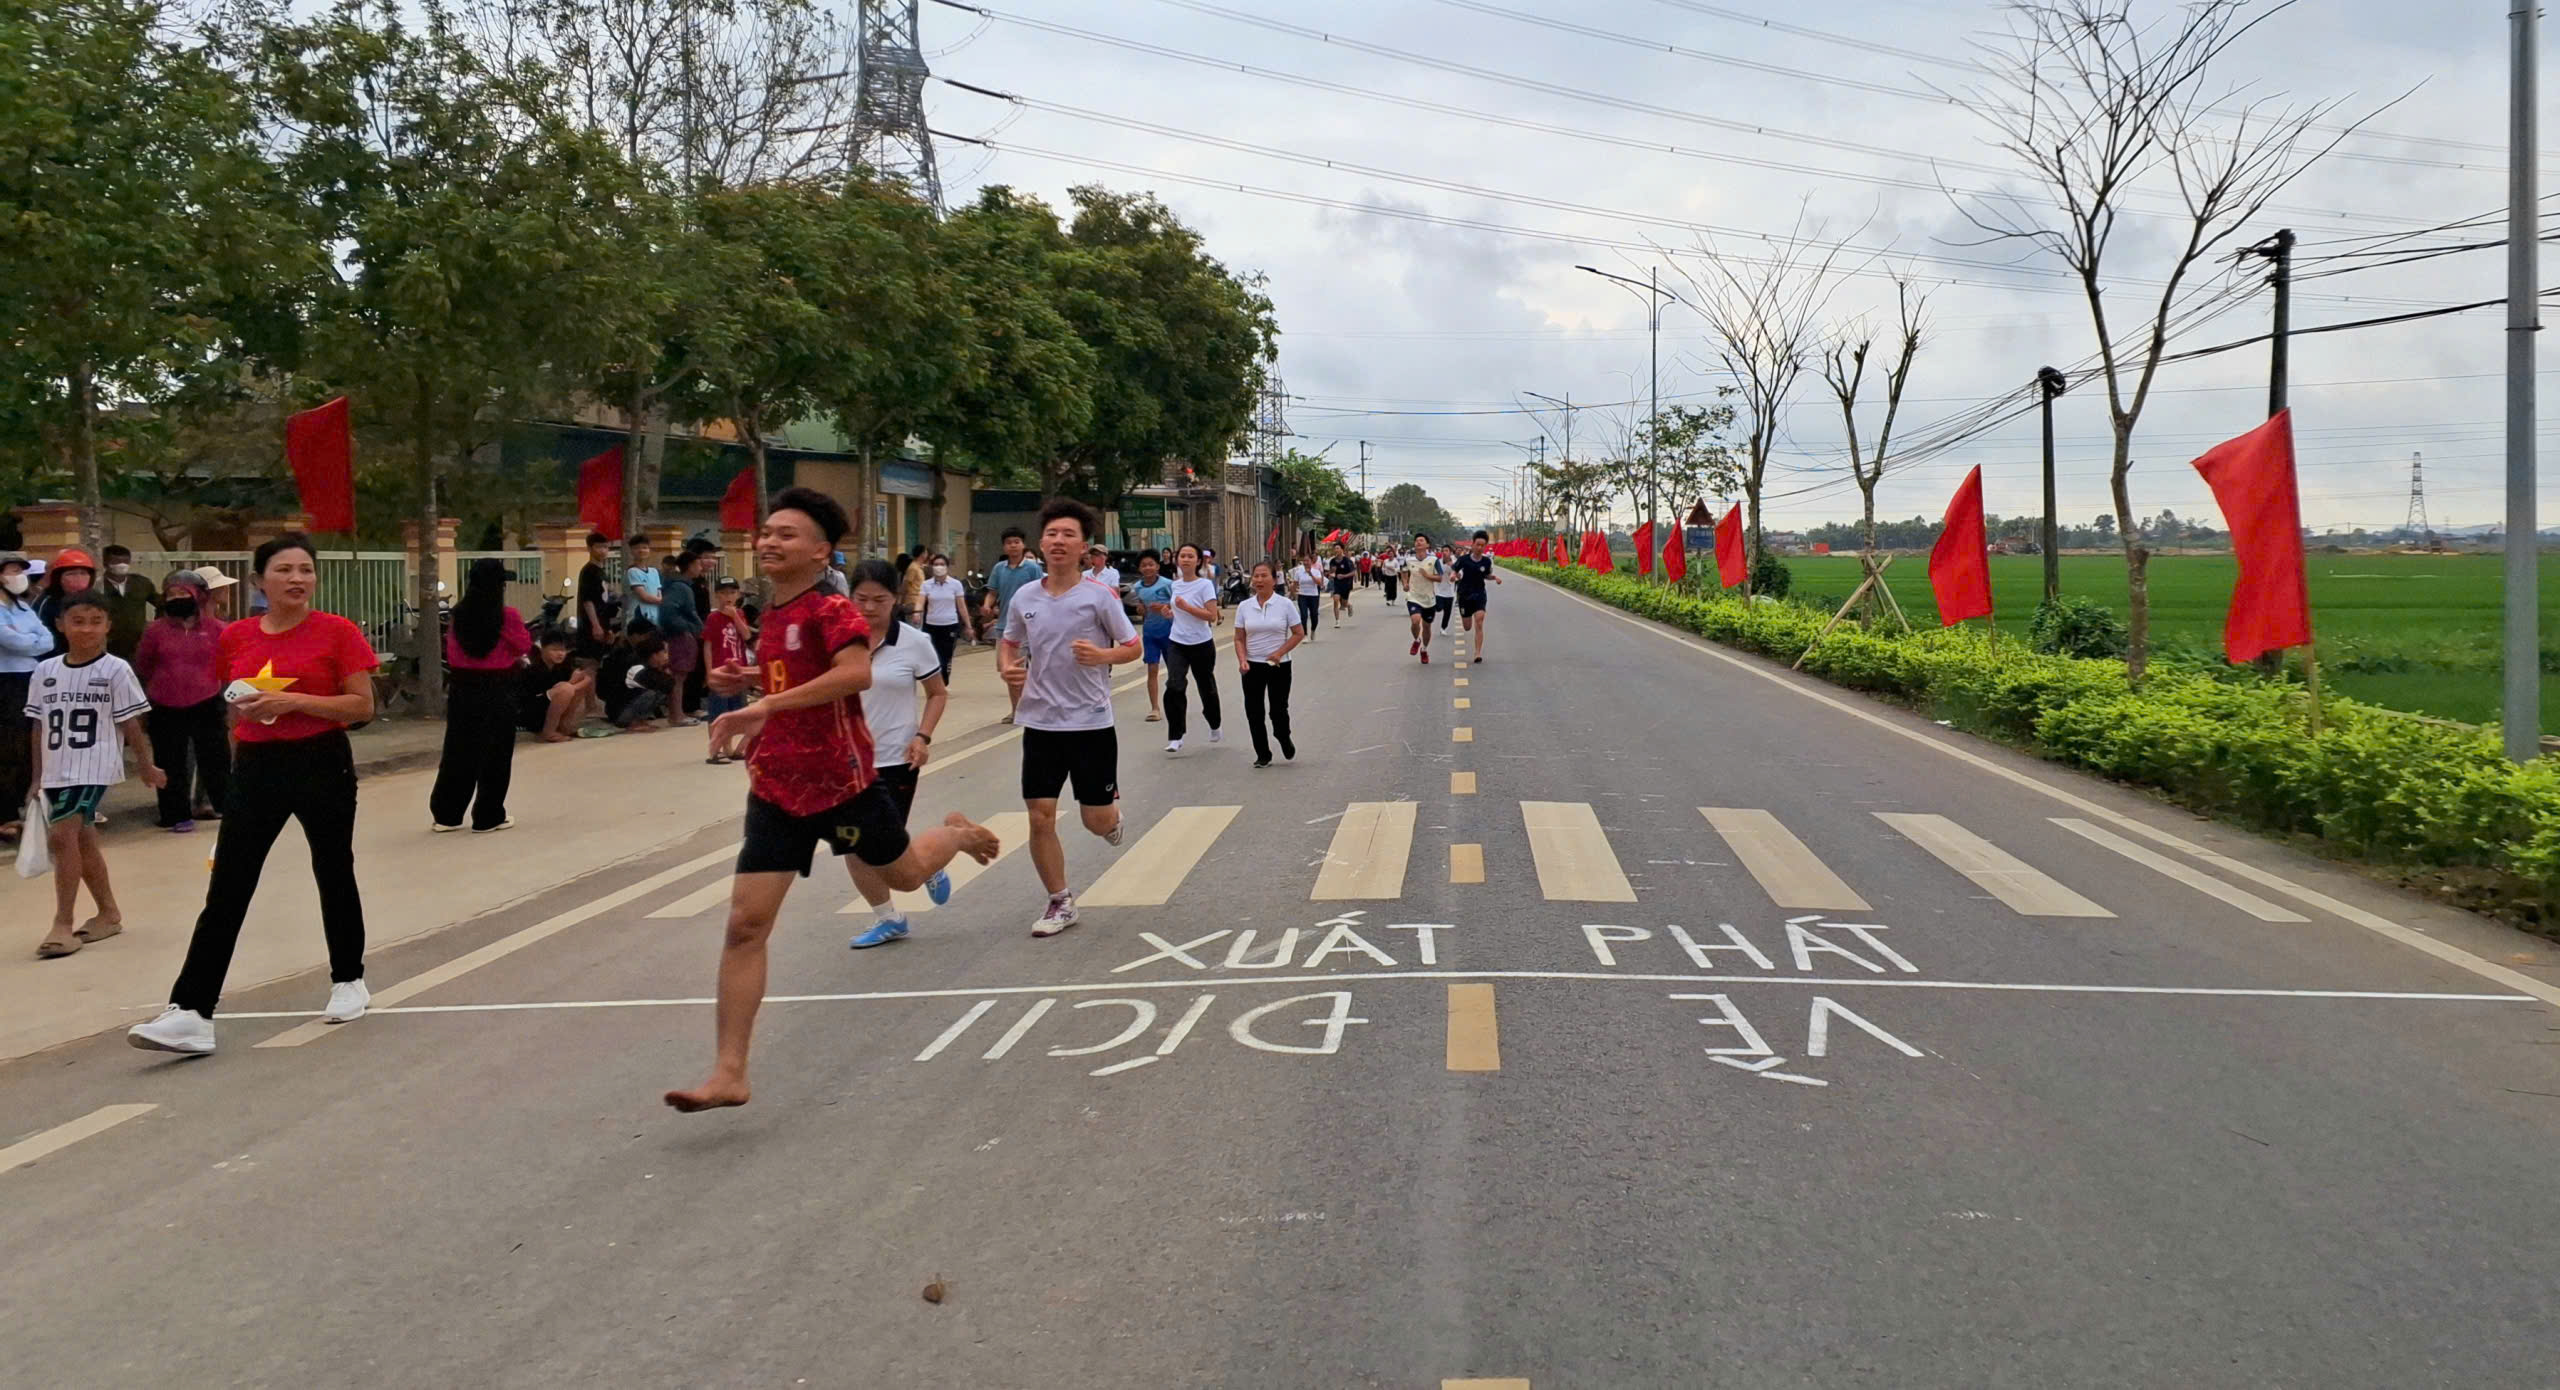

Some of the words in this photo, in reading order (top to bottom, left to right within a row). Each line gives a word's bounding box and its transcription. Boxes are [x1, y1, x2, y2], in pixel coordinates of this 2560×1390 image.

[60, 691, 111, 703] EVENING
[47, 708, 98, 750] 89
[1110, 910, 1456, 973] XUẤT
[1581, 915, 1919, 973] PHÁT
[1668, 993, 1926, 1086] VỀ
